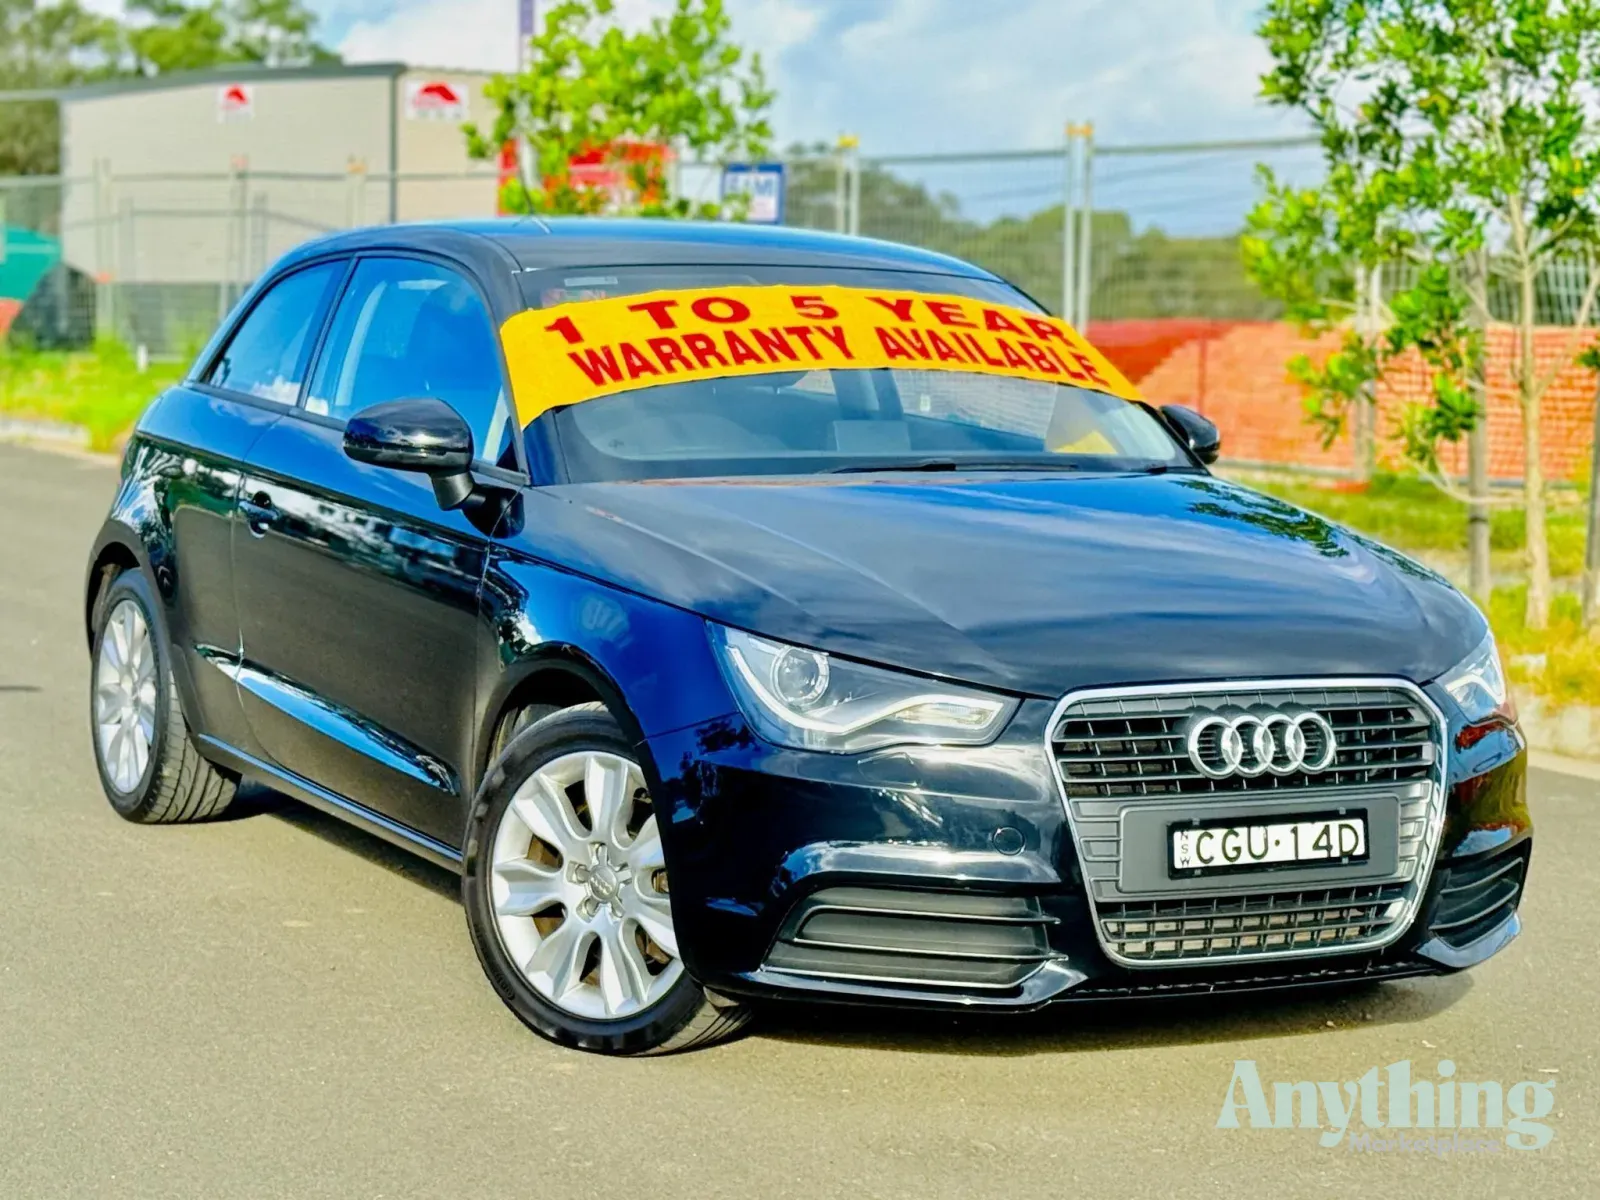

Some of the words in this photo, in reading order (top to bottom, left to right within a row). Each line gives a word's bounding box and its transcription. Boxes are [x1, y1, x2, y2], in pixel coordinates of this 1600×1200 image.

[544, 316, 584, 345] 1
[627, 296, 751, 330] TO
[790, 295, 839, 321] 5
[864, 296, 1078, 349] YEAR
[567, 325, 855, 387] WARRANTY
[874, 326, 1112, 388] AVAILABLE
